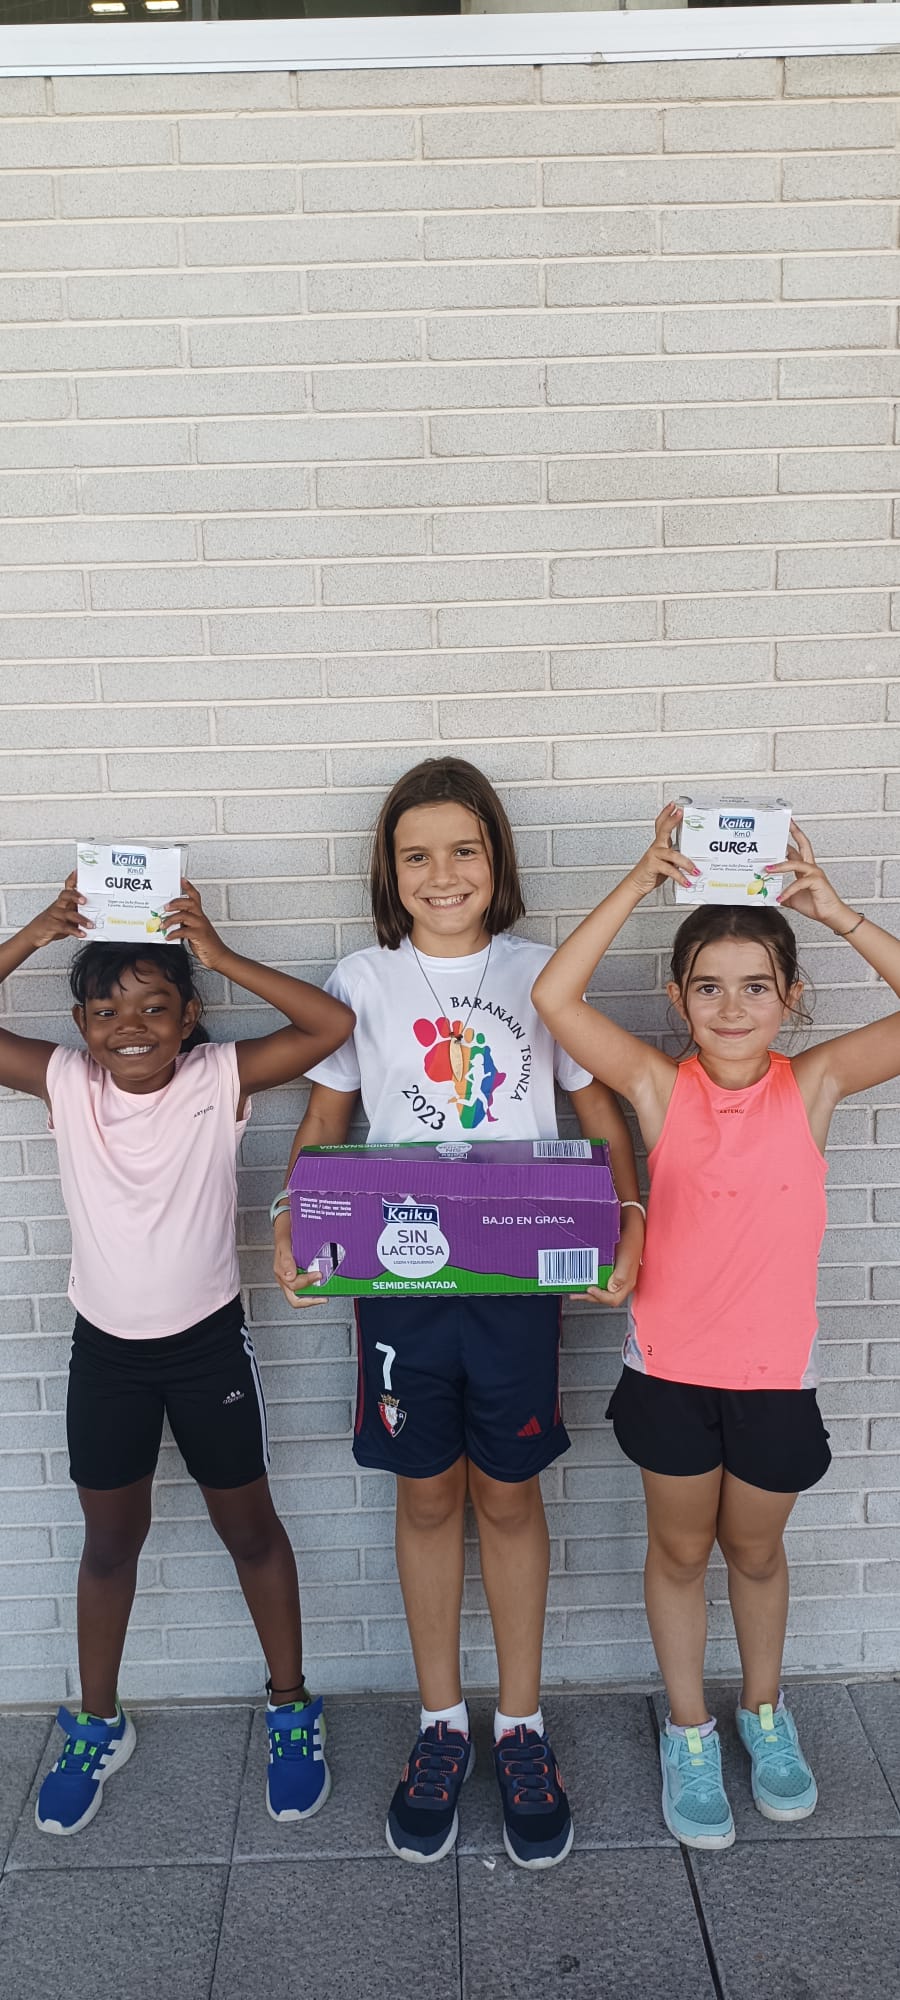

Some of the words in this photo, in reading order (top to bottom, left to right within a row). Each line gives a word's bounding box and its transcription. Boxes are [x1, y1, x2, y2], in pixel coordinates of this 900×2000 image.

[721, 817, 752, 830] Kaiku
[709, 841, 758, 855] GUREA
[114, 853, 144, 866] Kaiku
[105, 876, 152, 892] GUREA
[449, 996, 526, 1040] BARAÑAIN
[510, 1044, 532, 1102] TSUNZA
[401, 1084, 446, 1131] 2023
[388, 1207, 433, 1223] Kaiku
[482, 1215, 515, 1225] BAJO
[516, 1215, 532, 1225] EN
[534, 1215, 575, 1225] GRASA
[397, 1230, 427, 1243] SIN
[381, 1245, 445, 1256] LACTOSA
[372, 1280, 458, 1290] SEMIDESNATADA
[375, 1341, 397, 1391] 7
